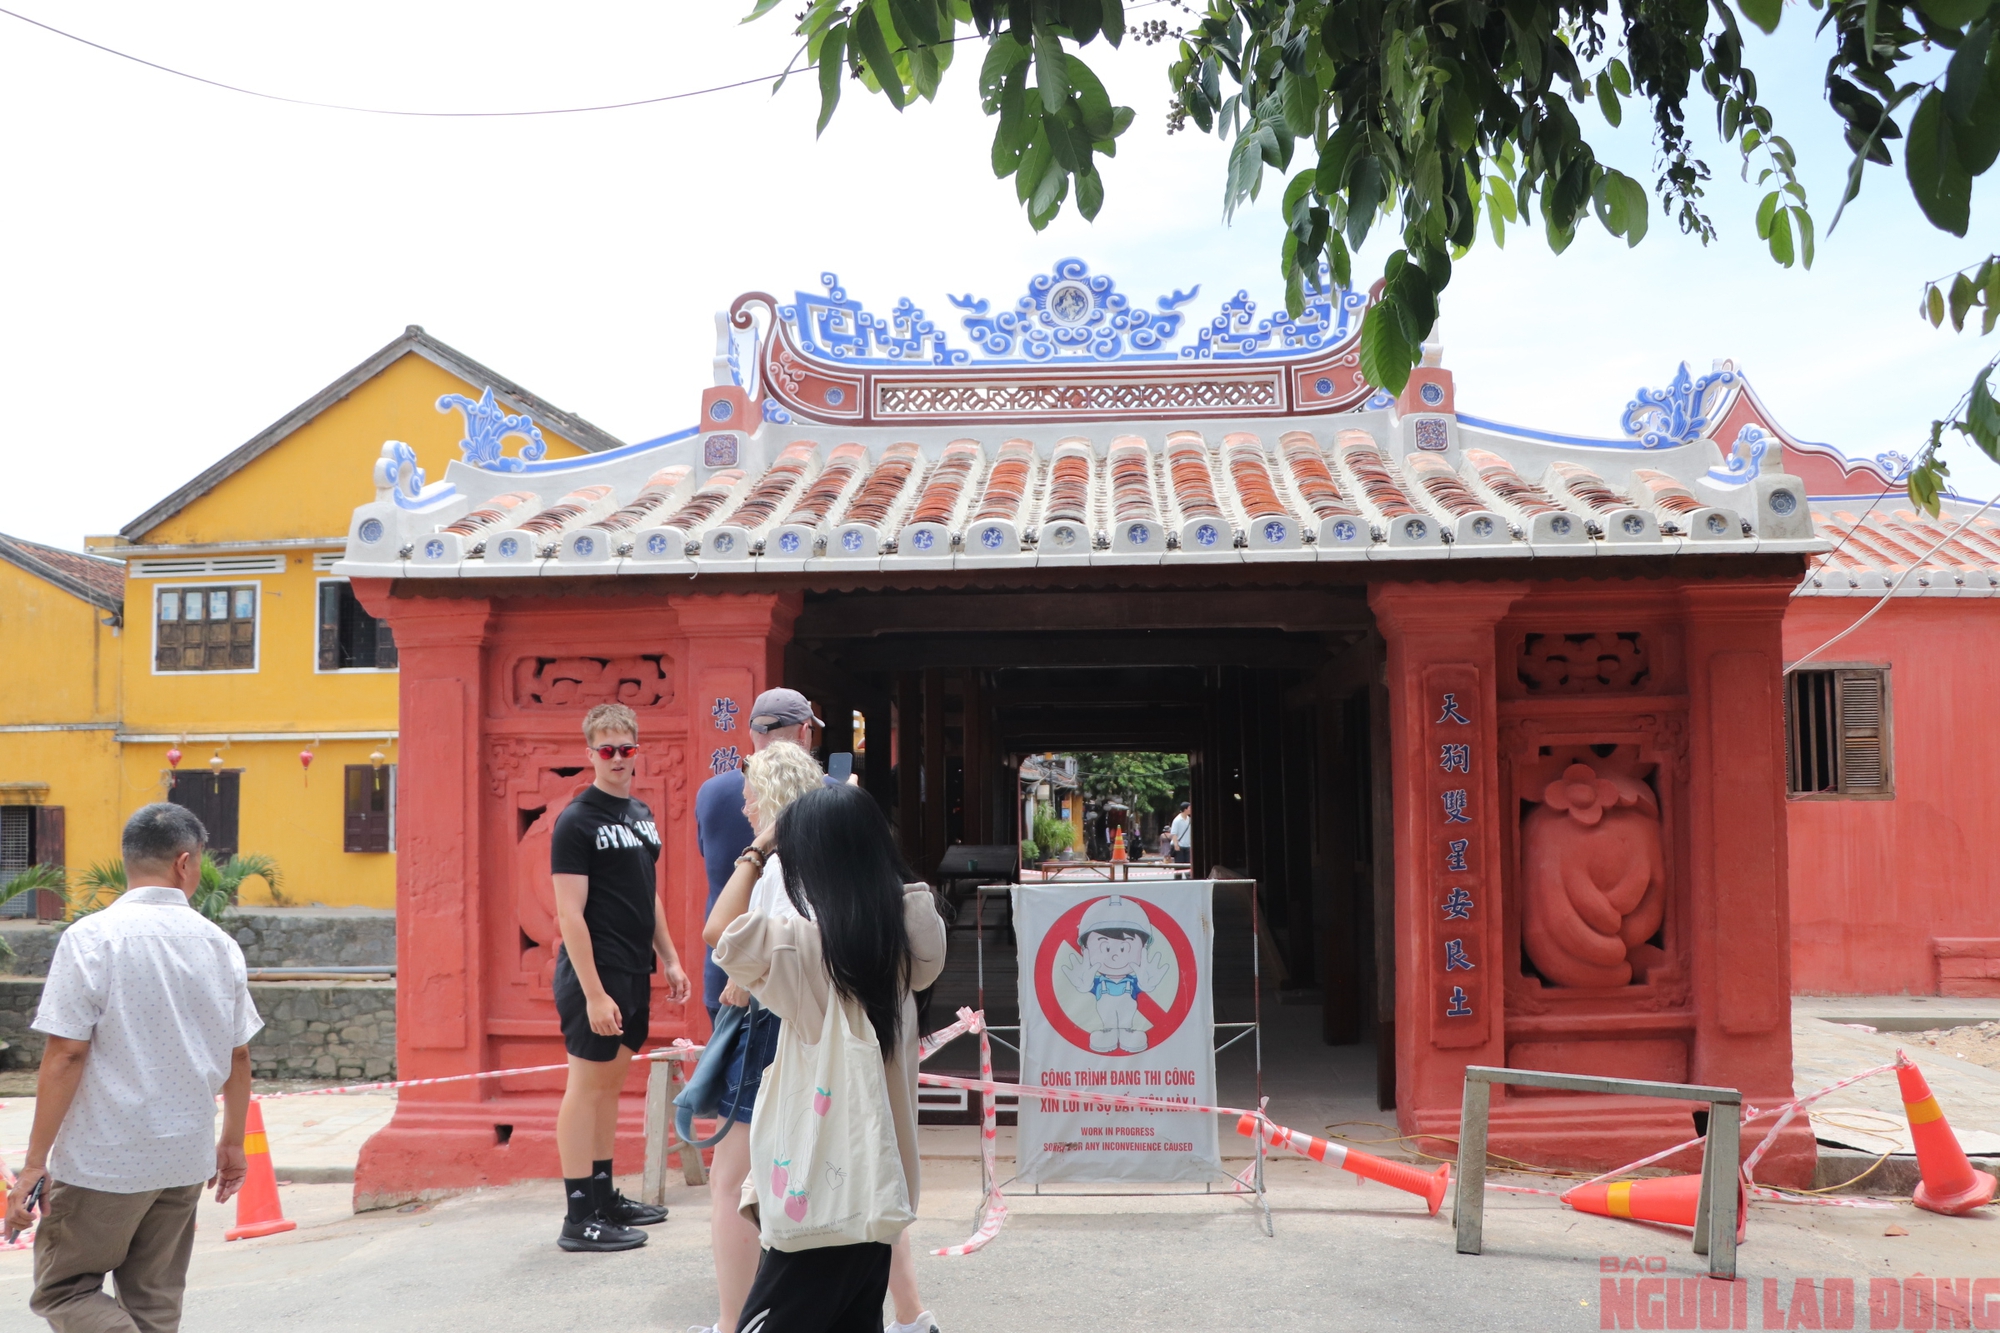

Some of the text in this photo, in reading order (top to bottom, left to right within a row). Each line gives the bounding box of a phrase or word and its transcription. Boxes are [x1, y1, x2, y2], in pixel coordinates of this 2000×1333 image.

[1041, 1067, 1195, 1087] CÔNG TRÌNH ĐANG THI CÔNG
[1041, 1097, 1060, 1113] XIN
[1081, 1127, 1155, 1137] WORK IN PROGRESS
[1085, 1142, 1101, 1151] ANY
[1102, 1142, 1162, 1152] INCONVENIENCE
[1163, 1142, 1193, 1152] CAUSED
